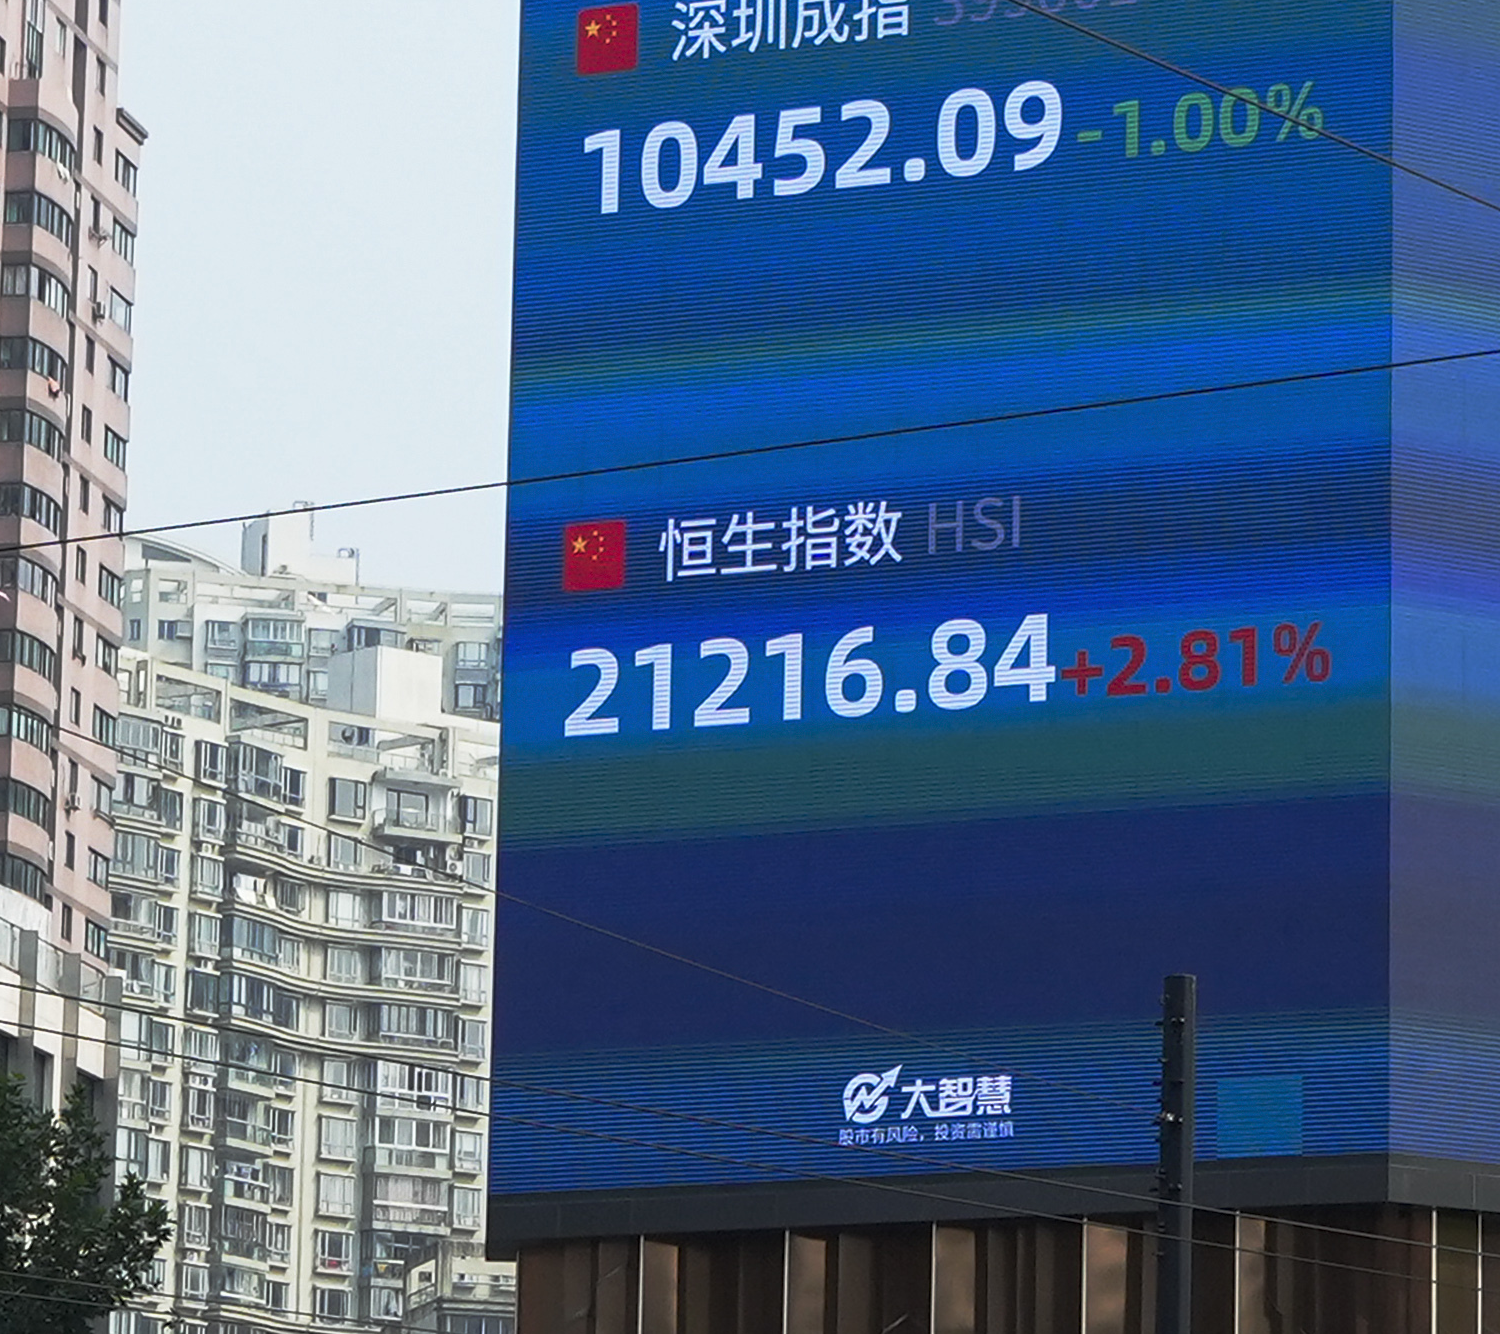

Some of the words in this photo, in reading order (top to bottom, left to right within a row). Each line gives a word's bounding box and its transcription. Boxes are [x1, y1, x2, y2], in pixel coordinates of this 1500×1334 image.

[582, 78, 1064, 215] 10452.09
[1075, 81, 1325, 161] -1.00%
[659, 501, 904, 581] 恒生指数
[926, 495, 1023, 555] HSI
[563, 612, 1056, 737] 21216.84
[1059, 622, 1332, 699] +2.81%
[901, 1075, 1012, 1119] 大智慧
